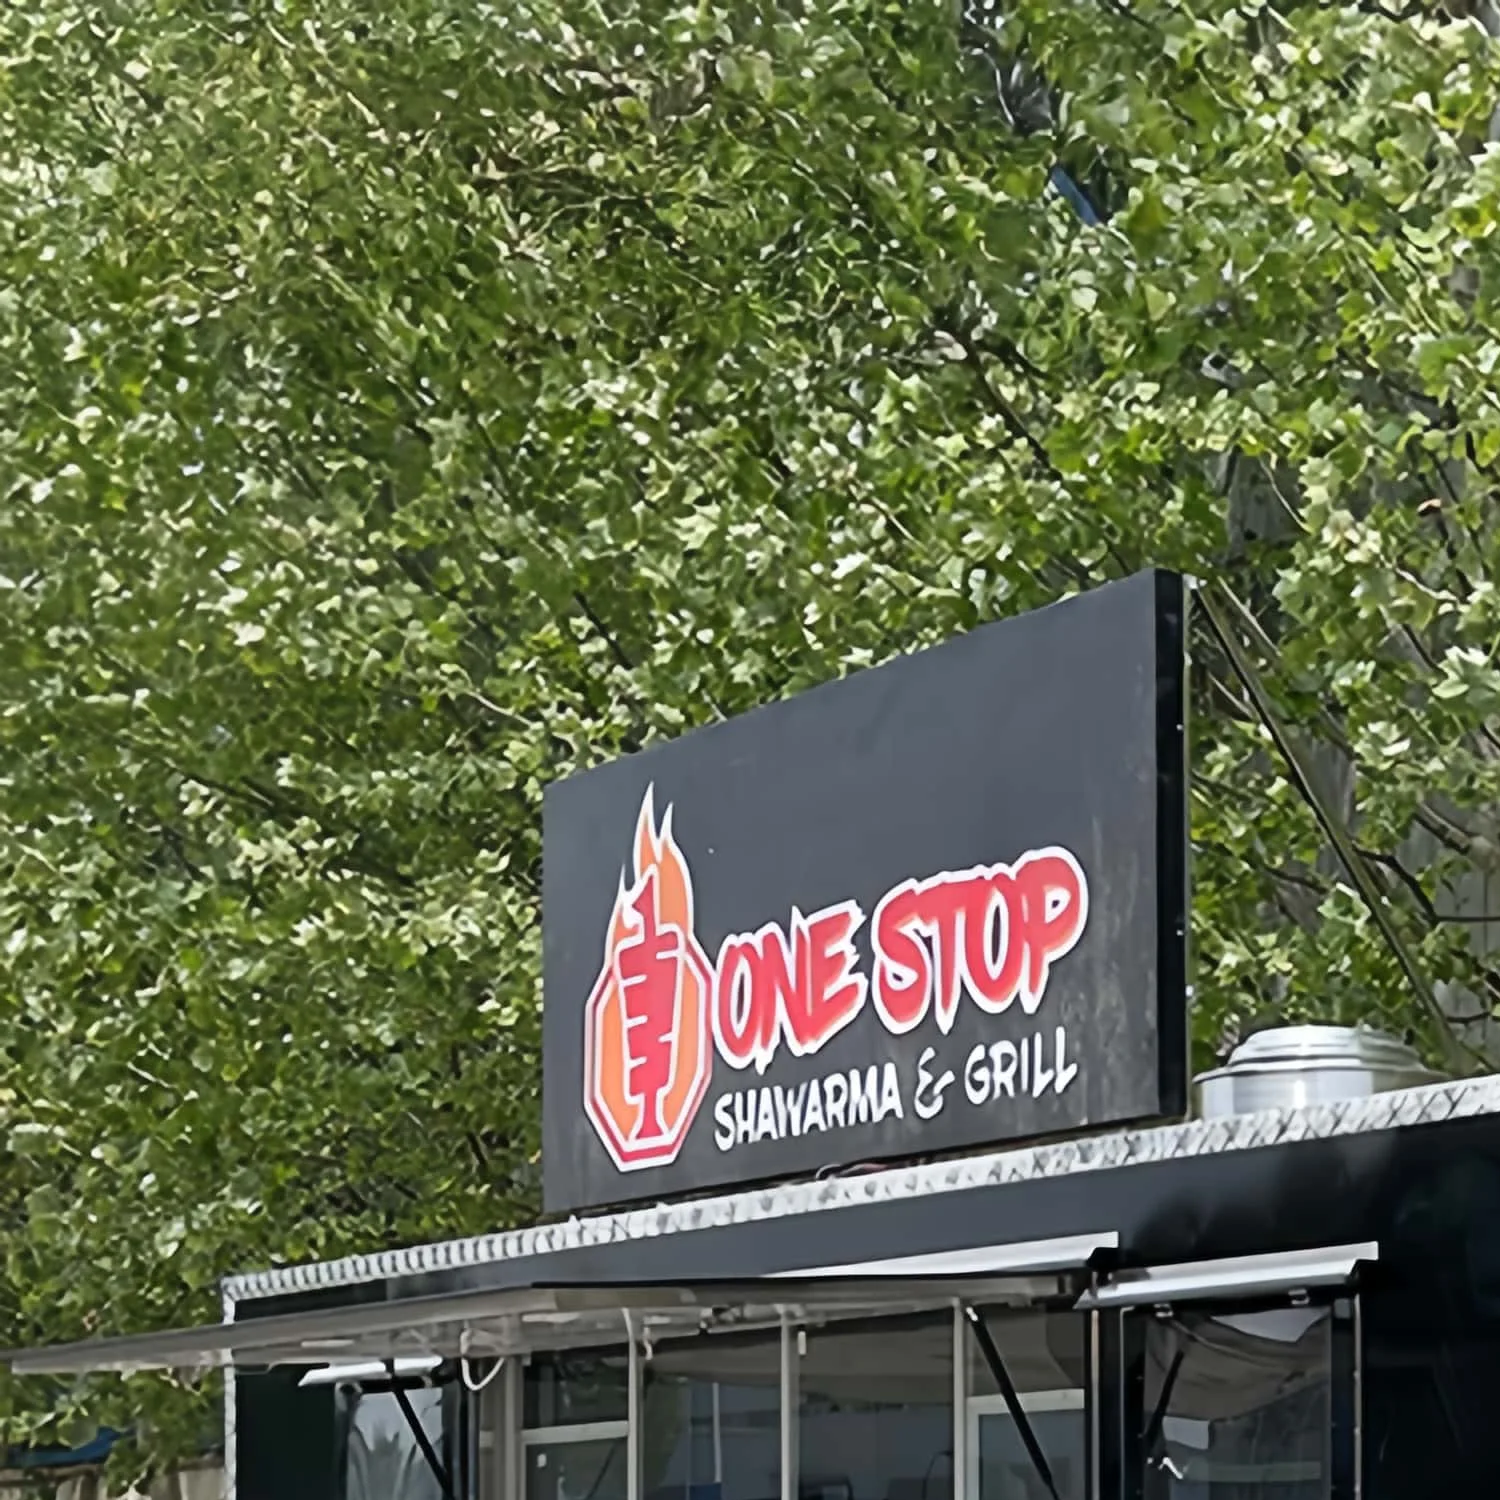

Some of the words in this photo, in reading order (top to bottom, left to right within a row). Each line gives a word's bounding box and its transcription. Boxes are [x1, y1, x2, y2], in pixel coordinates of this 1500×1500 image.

[712, 899, 867, 1073] ONE
[871, 846, 1089, 1034] STOP
[713, 1062, 903, 1151] SHAWARMA
[915, 1047, 956, 1119] &
[964, 1027, 1077, 1104] GRILL
